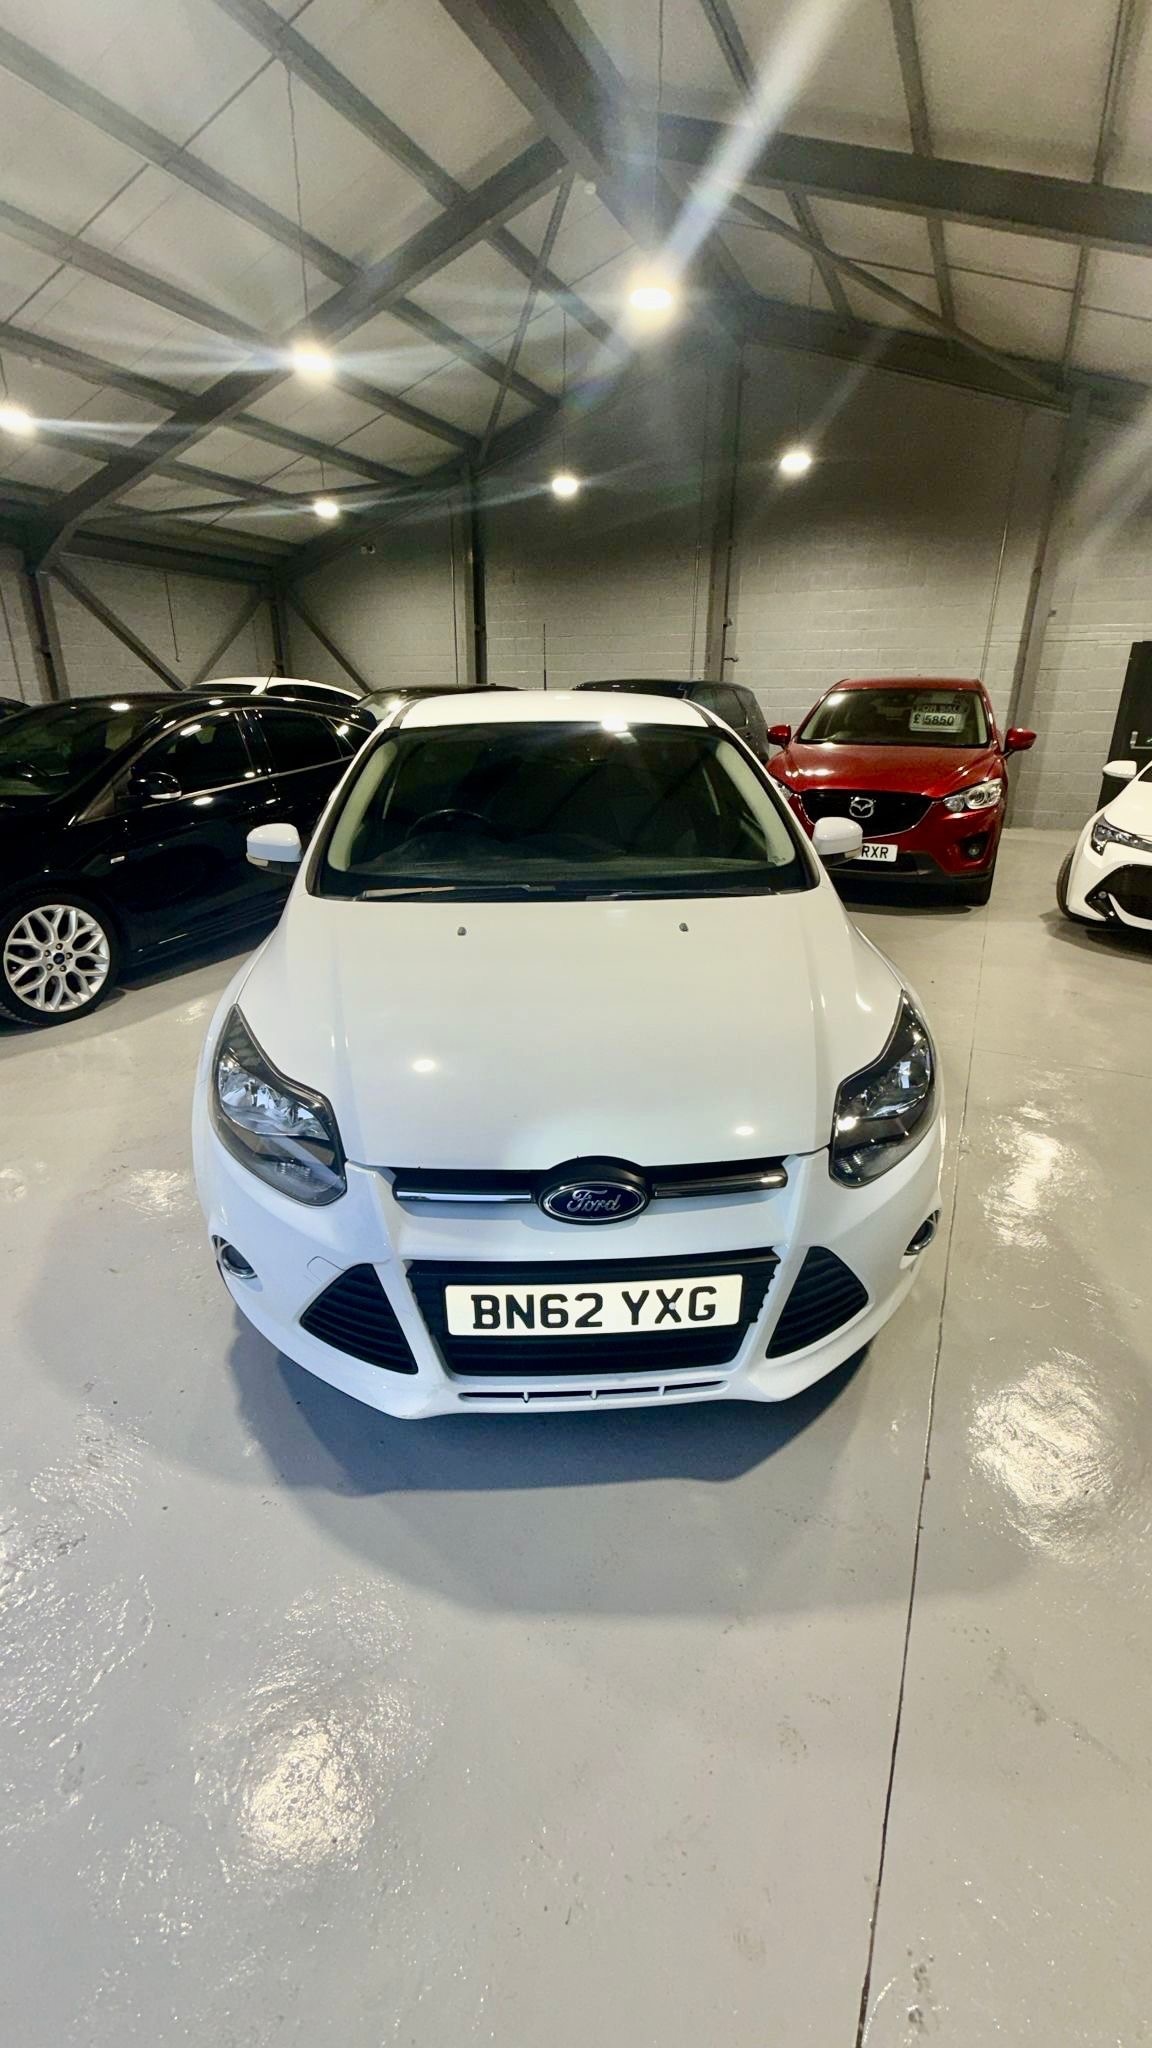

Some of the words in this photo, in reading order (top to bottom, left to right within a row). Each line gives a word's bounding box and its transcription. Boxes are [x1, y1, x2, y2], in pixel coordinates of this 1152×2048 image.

[861, 846, 888, 859] RXR
[566, 1189, 621, 1213] Ford
[470, 1293, 604, 1330] BN62
[621, 1286, 717, 1326] YXG
